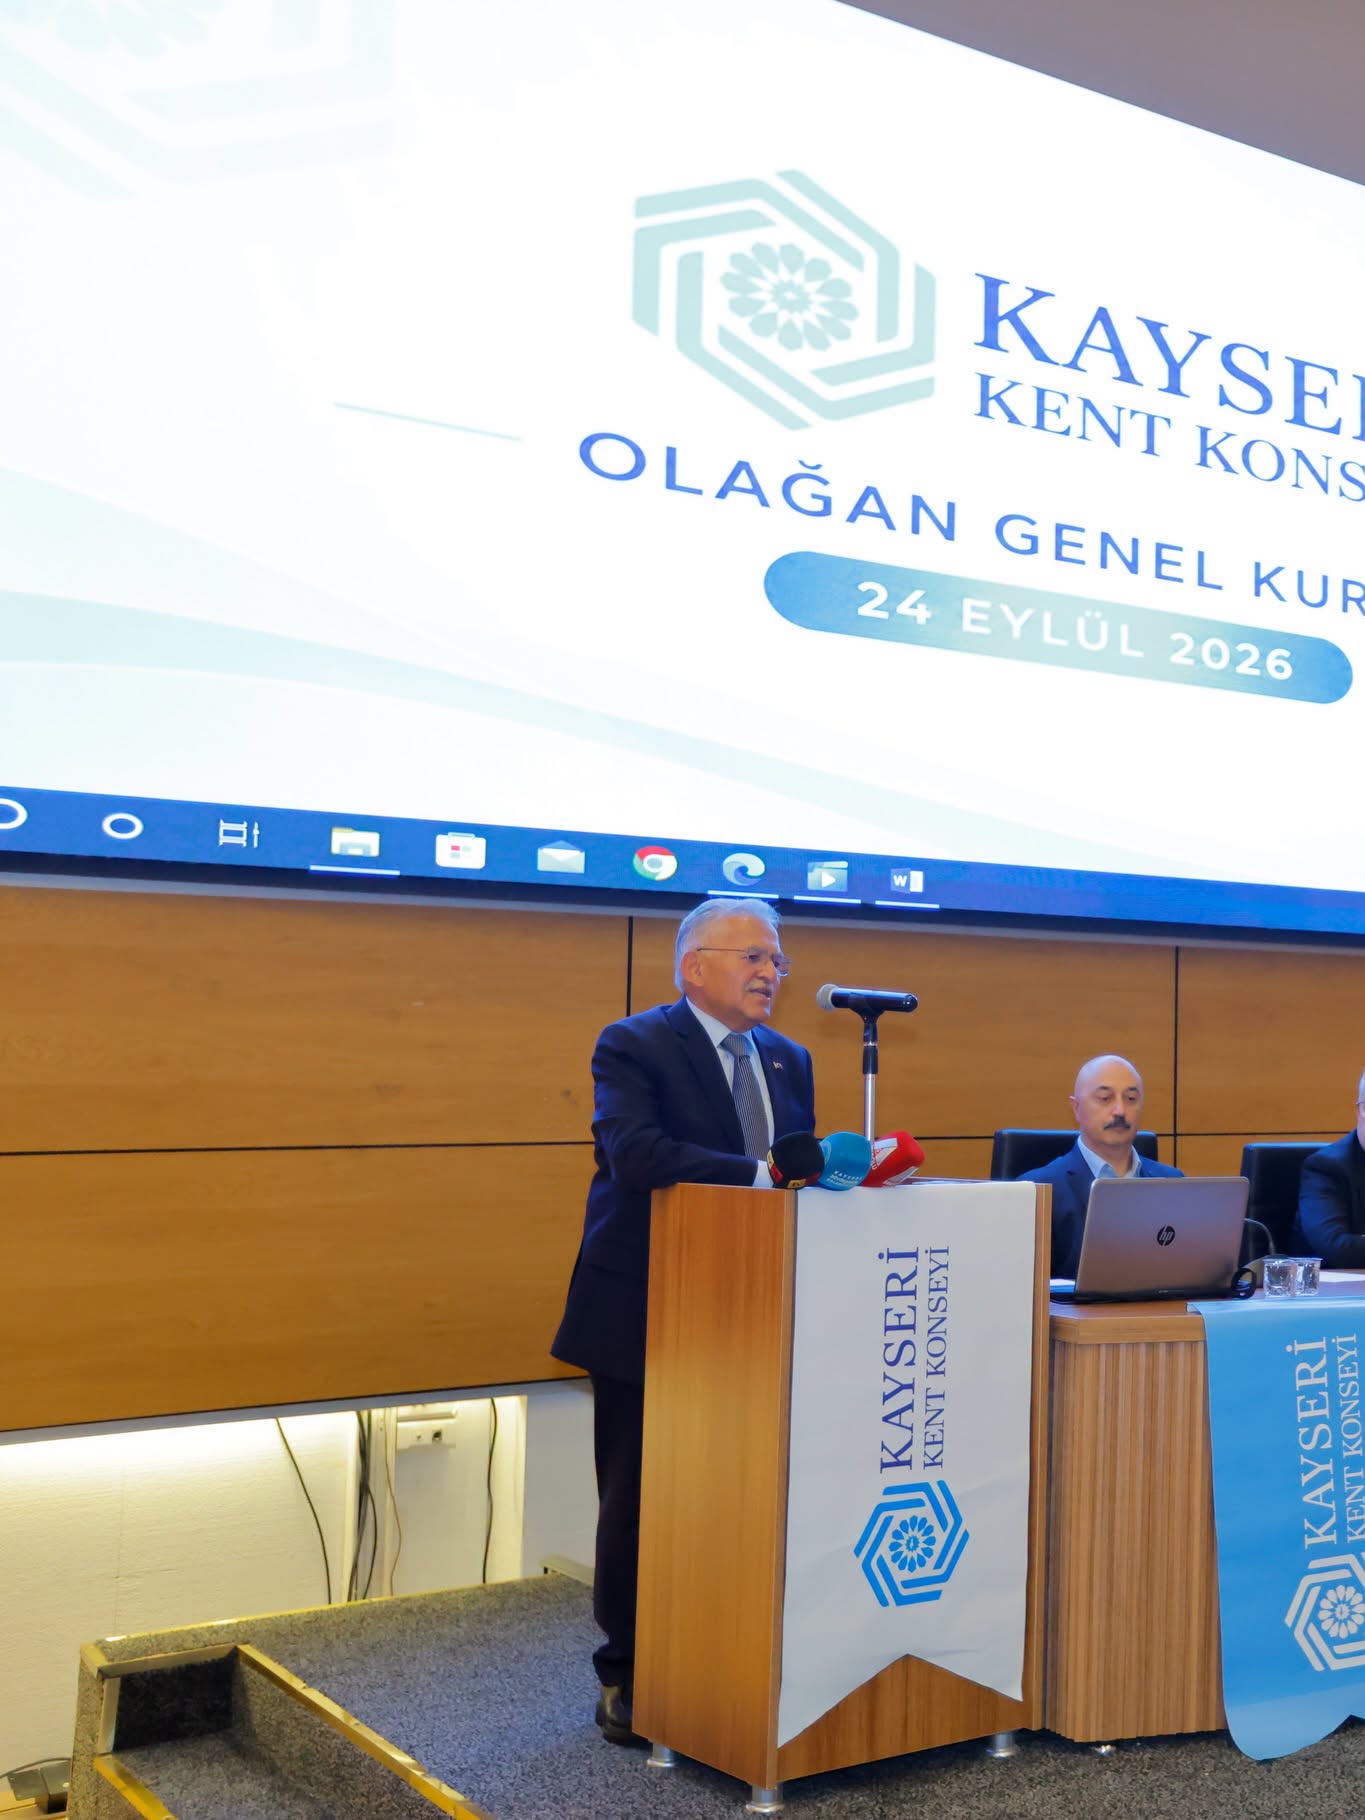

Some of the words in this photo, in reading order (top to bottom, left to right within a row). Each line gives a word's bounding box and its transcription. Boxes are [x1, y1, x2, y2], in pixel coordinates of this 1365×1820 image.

[974, 372, 1172, 457] KENT
[578, 431, 957, 542] OLAĞAN
[994, 512, 1224, 592] GENEL
[856, 581, 932, 624] 24
[961, 598, 1145, 658] EYLÜL
[1169, 631, 1294, 680] 2026
[893, 874, 908, 887] W
[1157, 1225, 1175, 1247] hp
[878, 1246, 919, 1474] KAYSERİ
[924, 1246, 950, 1378] KONSEYİ
[923, 1387, 946, 1470] KENT
[1285, 1336, 1338, 1550] KAYSERİ
[1331, 1333, 1364, 1459] KONSEYİ
